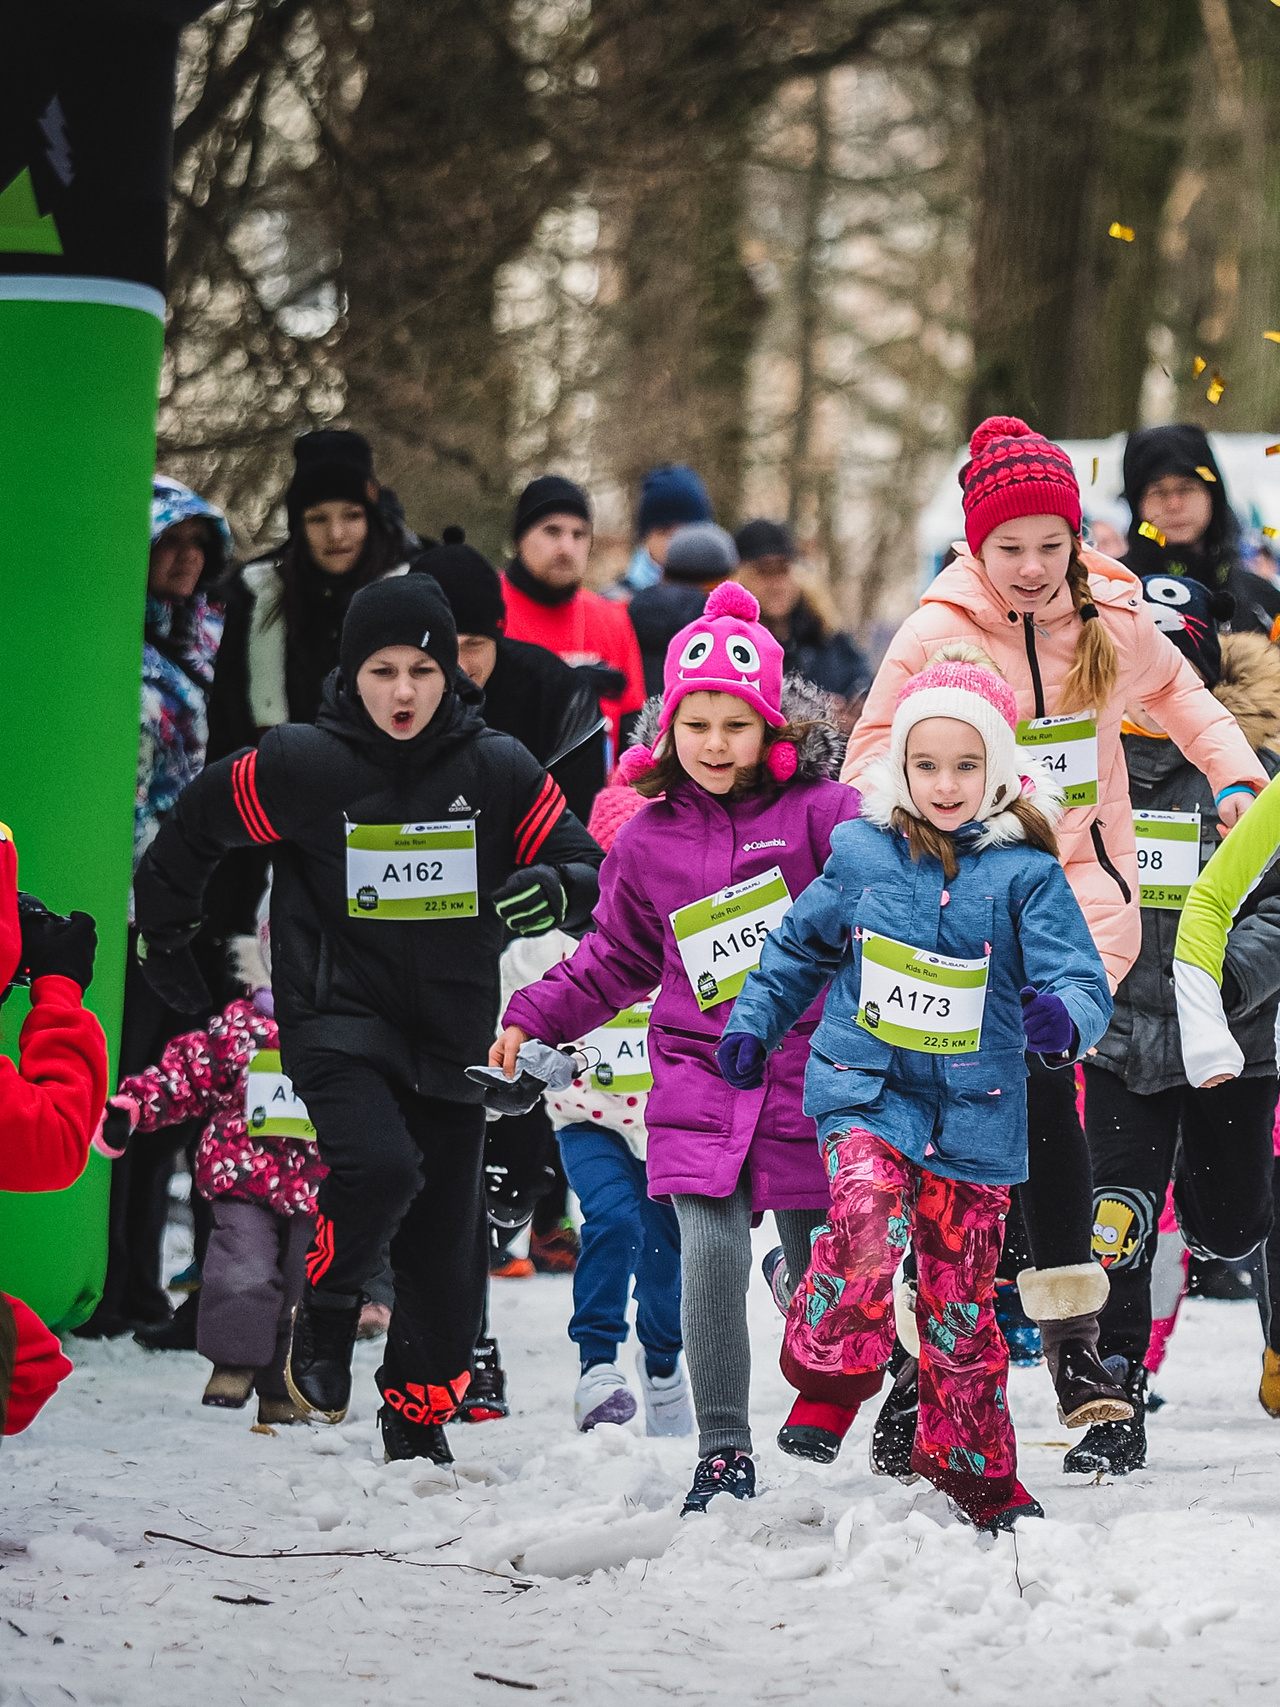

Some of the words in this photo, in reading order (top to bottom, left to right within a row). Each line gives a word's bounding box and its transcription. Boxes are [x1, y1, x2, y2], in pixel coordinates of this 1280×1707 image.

[1022, 733, 1037, 741] Kids
[1041, 753, 1067, 772] 64
[751, 839, 786, 850] Columbia
[1137, 850, 1162, 870] 98
[382, 861, 443, 882] A162
[1142, 890, 1164, 901] 22,5
[425, 901, 447, 912] 22,5
[710, 910, 725, 921] Kids
[726, 904, 741, 915] Run
[712, 920, 770, 962] A165
[905, 963, 921, 974] Kids
[923, 969, 938, 978] Run
[941, 960, 968, 969] SUBARU
[887, 985, 951, 1017] A173
[923, 1036, 949, 1048] 22,5
